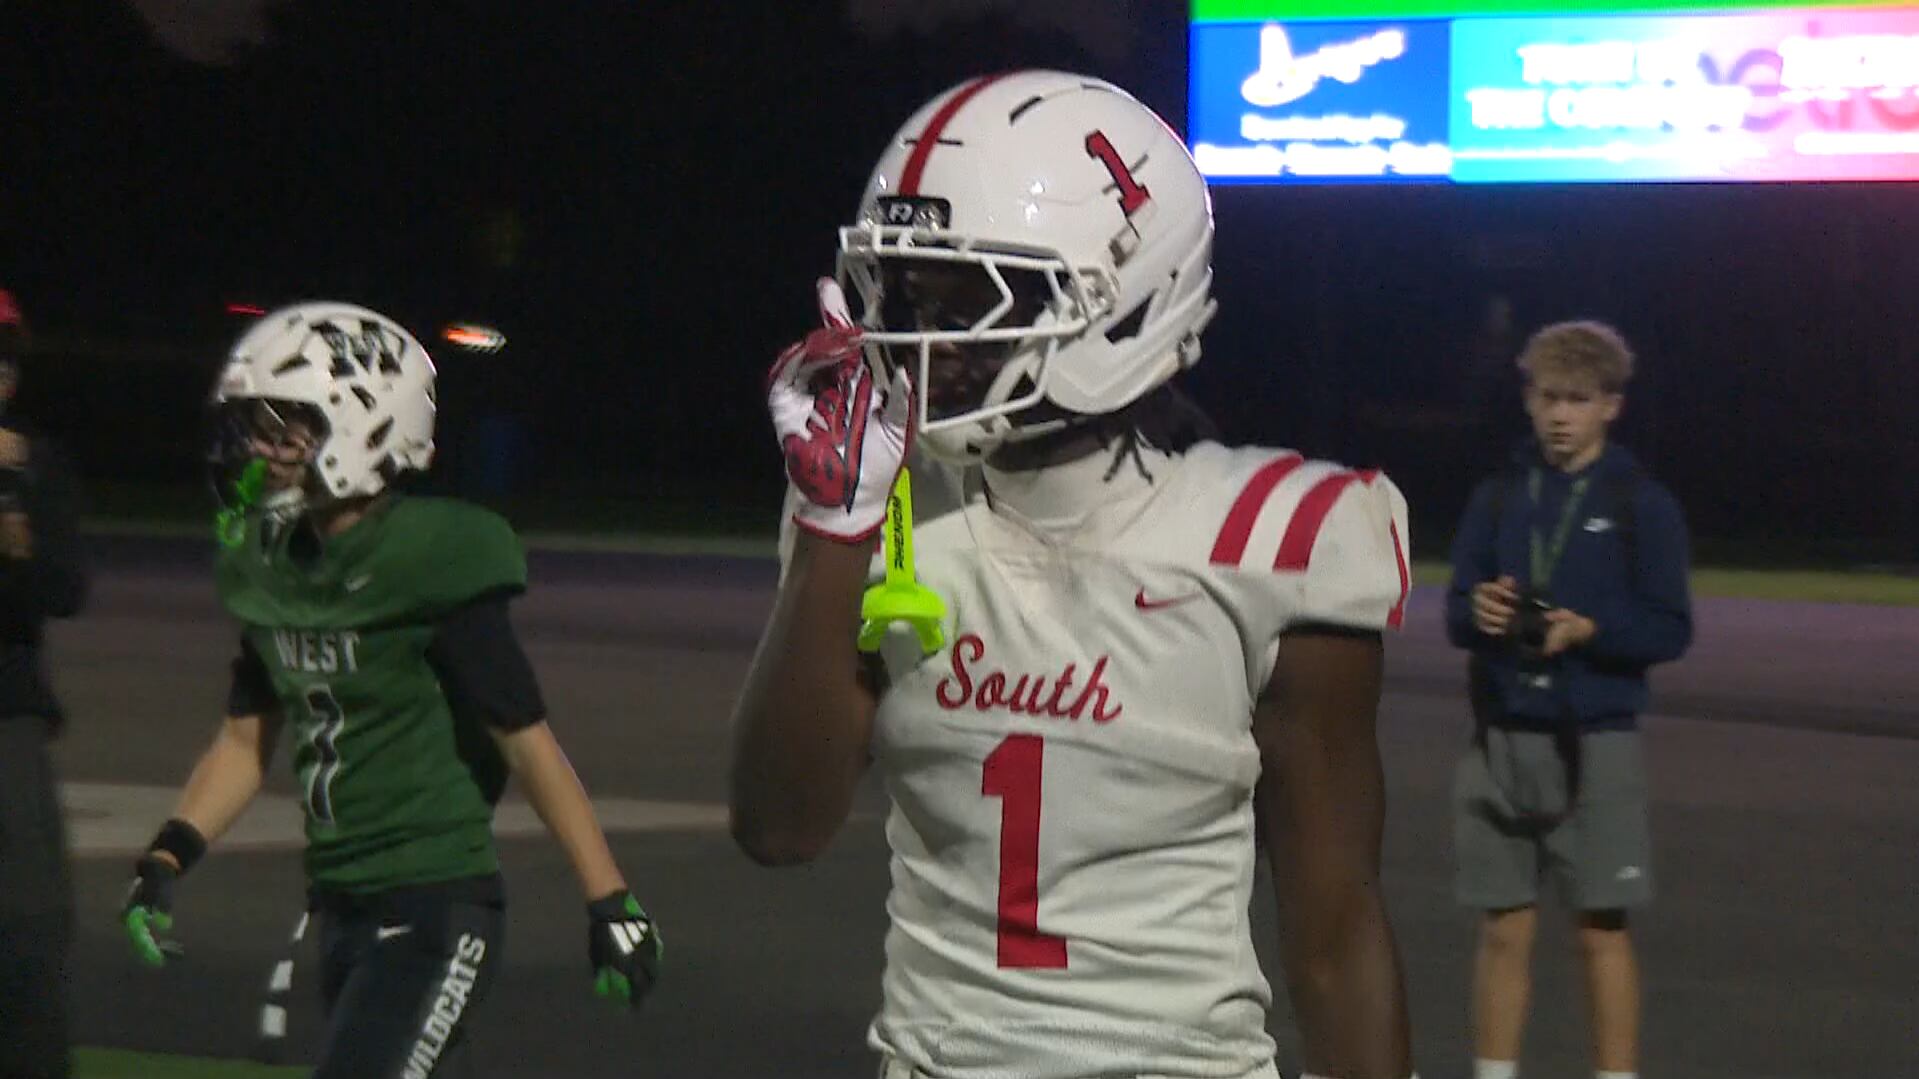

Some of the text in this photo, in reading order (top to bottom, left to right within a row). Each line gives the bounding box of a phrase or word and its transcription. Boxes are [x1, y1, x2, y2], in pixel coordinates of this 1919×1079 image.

[1085, 129, 1151, 217] 1
[275, 628, 360, 674] WEST
[935, 633, 1123, 725] South
[982, 733, 1067, 968] 1
